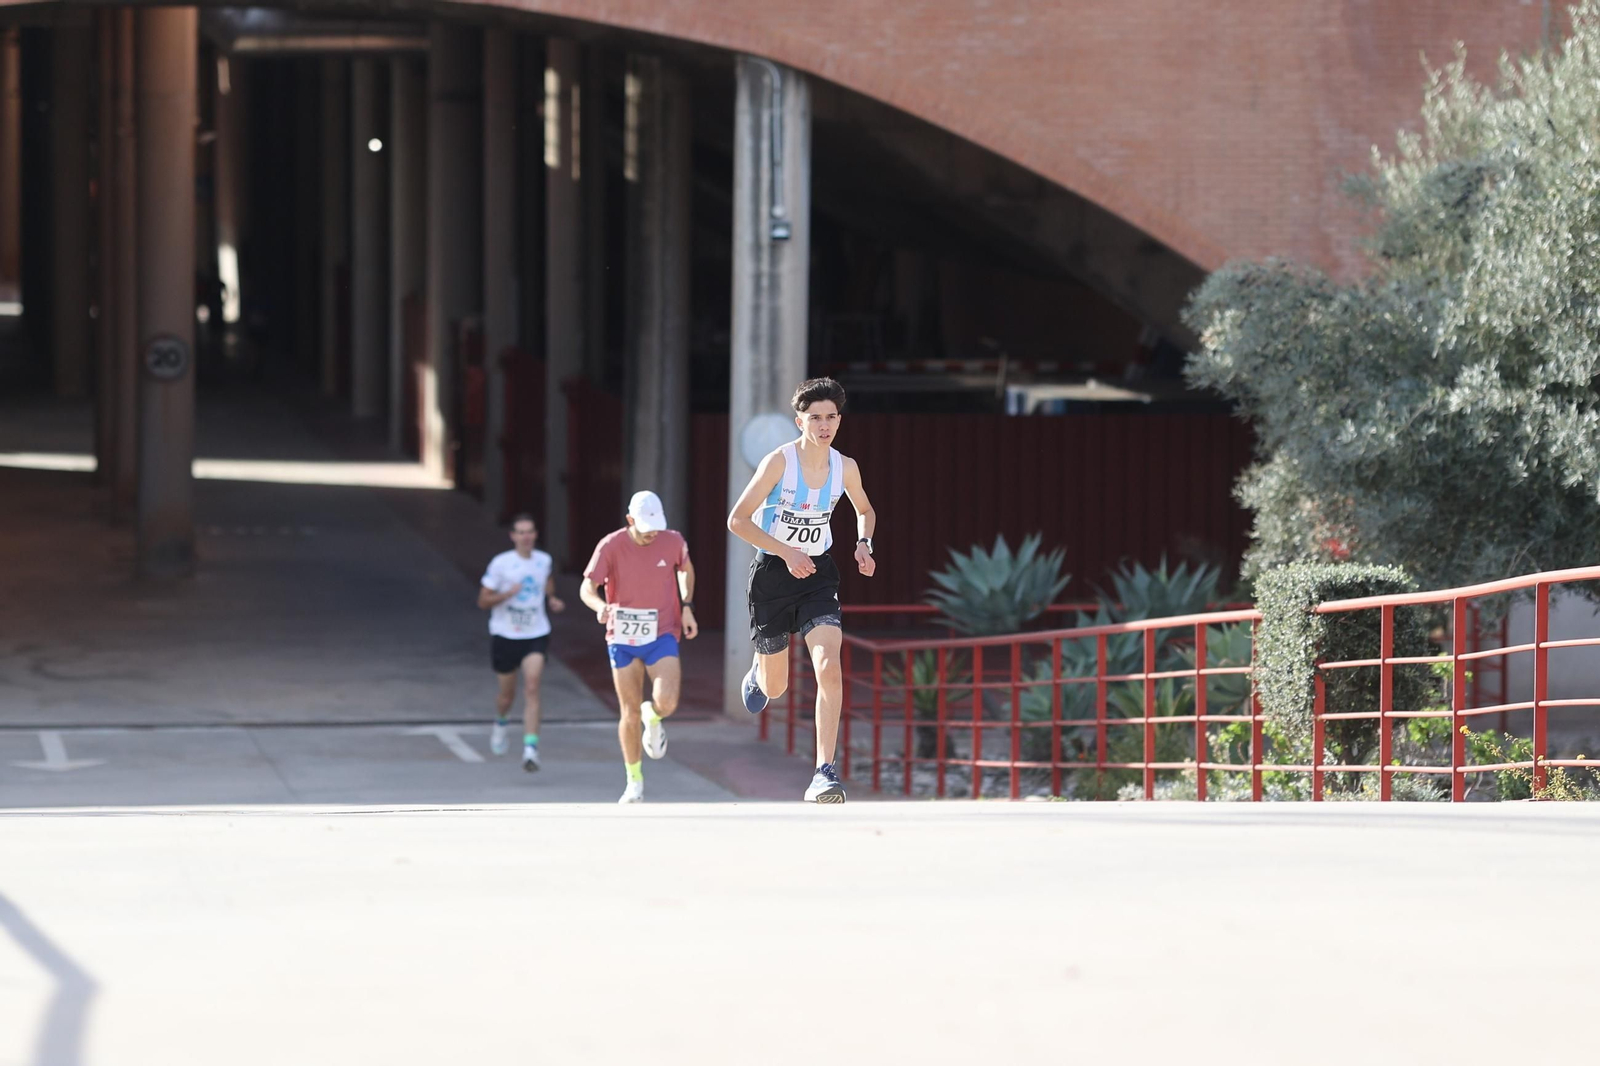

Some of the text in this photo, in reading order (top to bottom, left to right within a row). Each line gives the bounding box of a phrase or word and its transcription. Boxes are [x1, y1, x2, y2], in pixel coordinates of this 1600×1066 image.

[153, 346, 181, 368] 20
[782, 515, 806, 525] UMA
[786, 526, 821, 544] 700
[621, 622, 650, 636] 276
